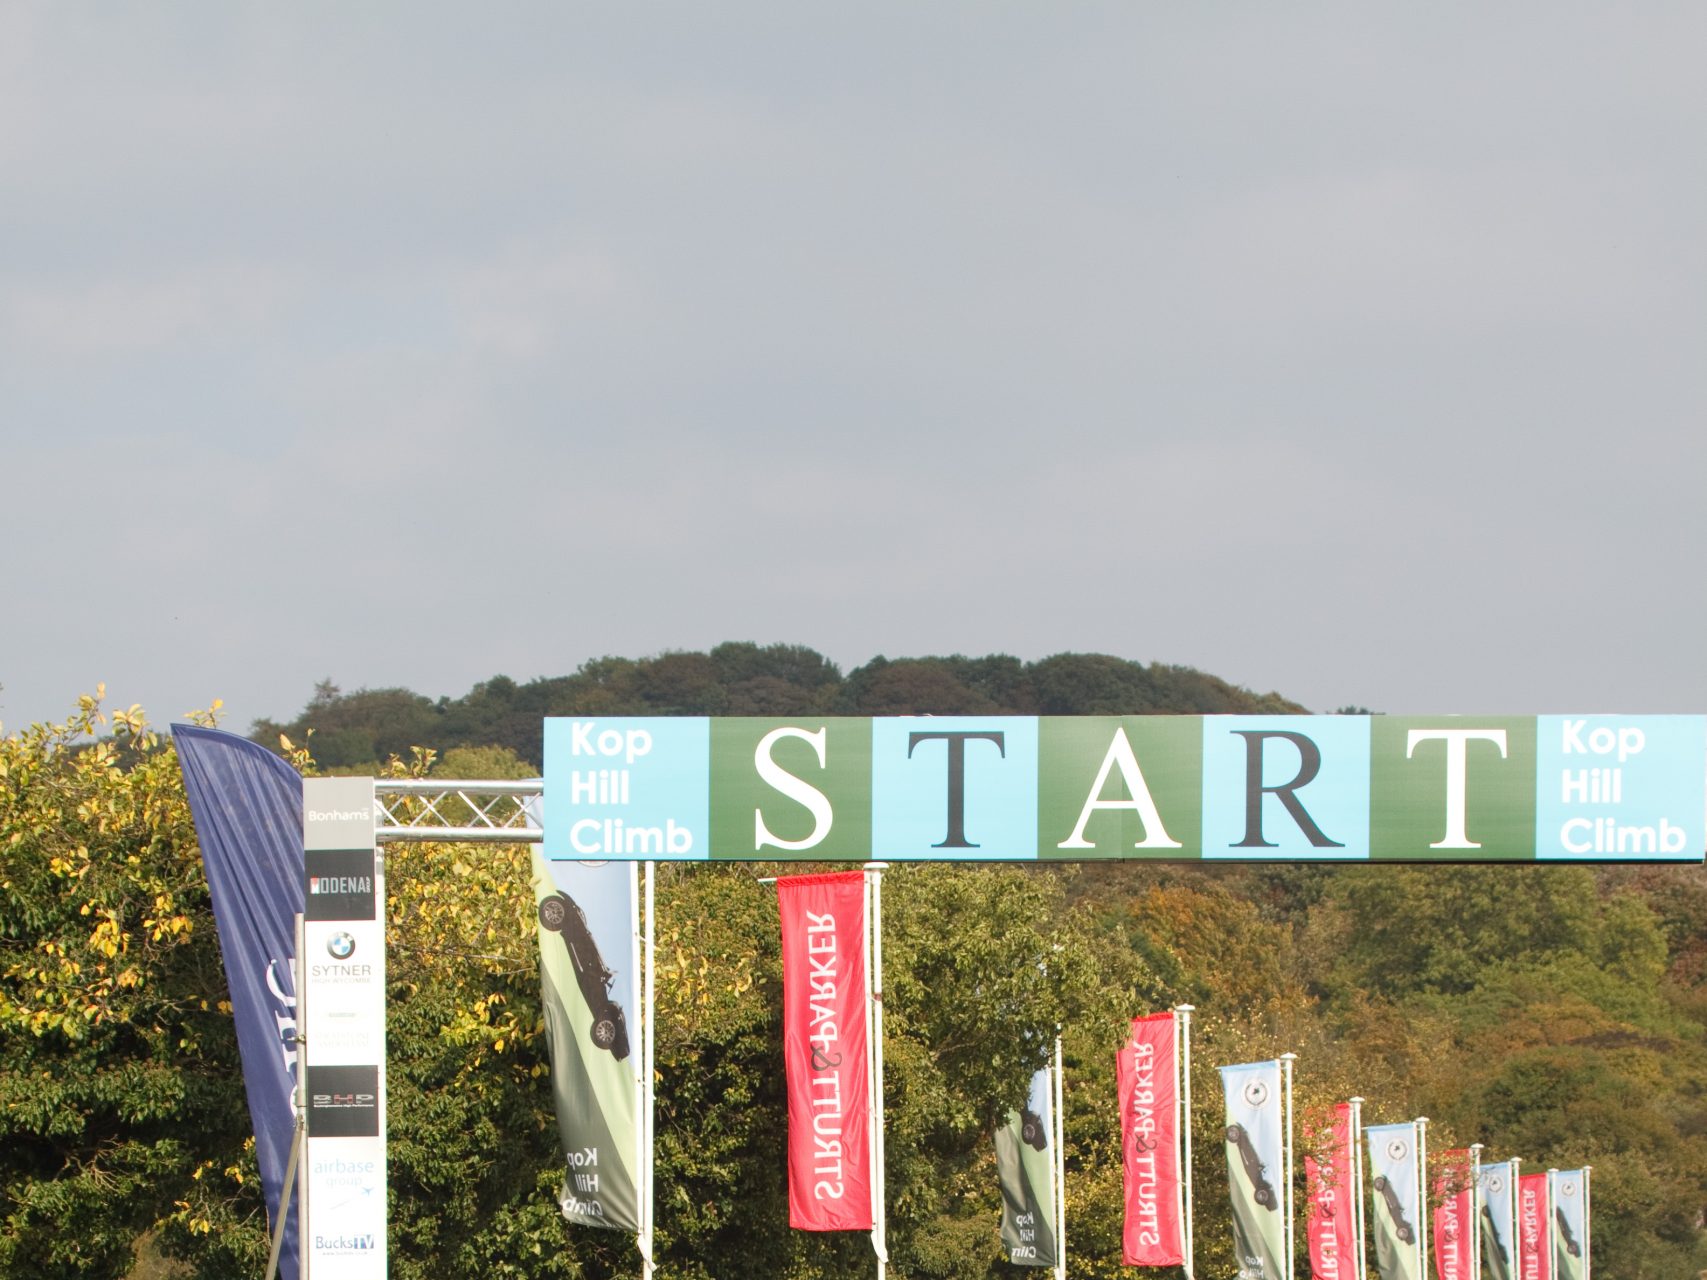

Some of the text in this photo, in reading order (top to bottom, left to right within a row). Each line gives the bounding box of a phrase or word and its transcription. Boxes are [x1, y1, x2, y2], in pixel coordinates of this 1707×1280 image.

[571, 721, 653, 763] Kop
[1561, 719, 1646, 762] Kop
[571, 769, 630, 805] Hill
[754, 727, 1508, 851] START
[1561, 768, 1622, 804] Hill
[308, 809, 370, 821] Bonhams
[569, 818, 693, 854] Climb
[1559, 817, 1688, 854] Climb
[312, 965, 371, 976] SYTNER
[314, 1158, 375, 1174] airbase
[315, 1234, 375, 1249] BucksTV
